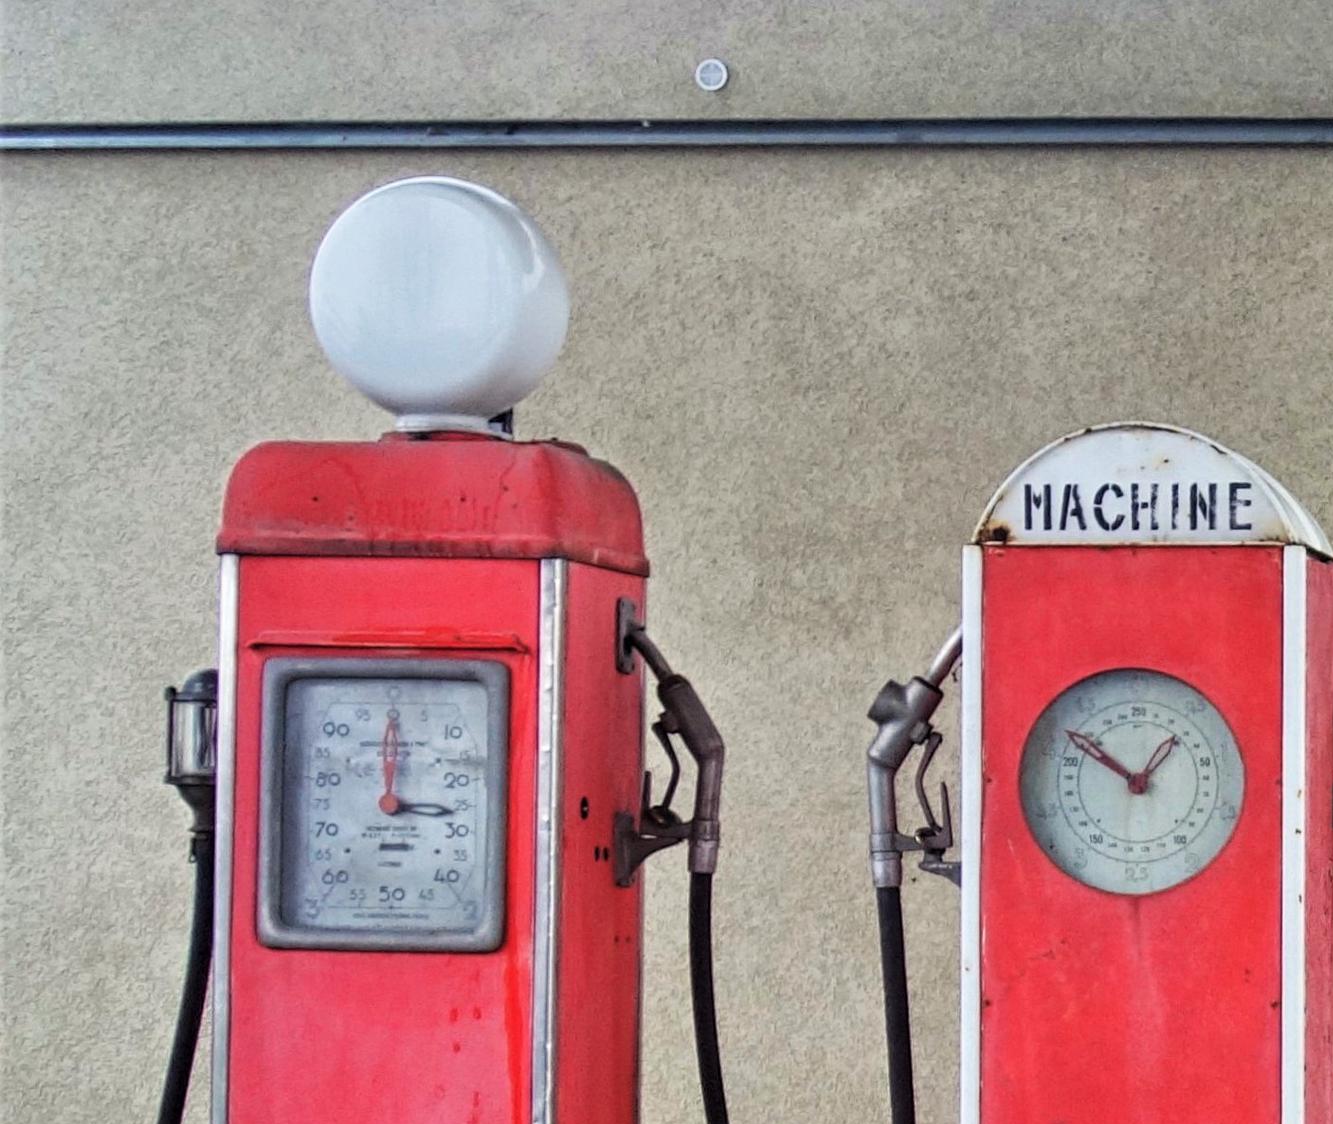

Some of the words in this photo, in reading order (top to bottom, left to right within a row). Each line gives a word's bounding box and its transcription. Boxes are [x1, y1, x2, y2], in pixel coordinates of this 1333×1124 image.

[1023, 482, 1252, 532] MACHINE
[420, 709, 429, 722] 5
[1131, 706, 1147, 717] 250
[322, 721, 351, 738] 90
[444, 724, 463, 741] 10
[1063, 757, 1079, 767] 200
[1199, 757, 1211, 768] 50
[315, 771, 342, 788] 80
[443, 772, 471, 789] 20
[315, 821, 339, 838] 70
[444, 822, 470, 839] 30
[1089, 834, 1104, 844] 150
[1173, 834, 1187, 845] 100
[321, 867, 350, 885] 60
[433, 867, 461, 884] 40
[349, 888, 367, 901] 55
[379, 886, 406, 902] 50
[418, 888, 435, 901] 45
